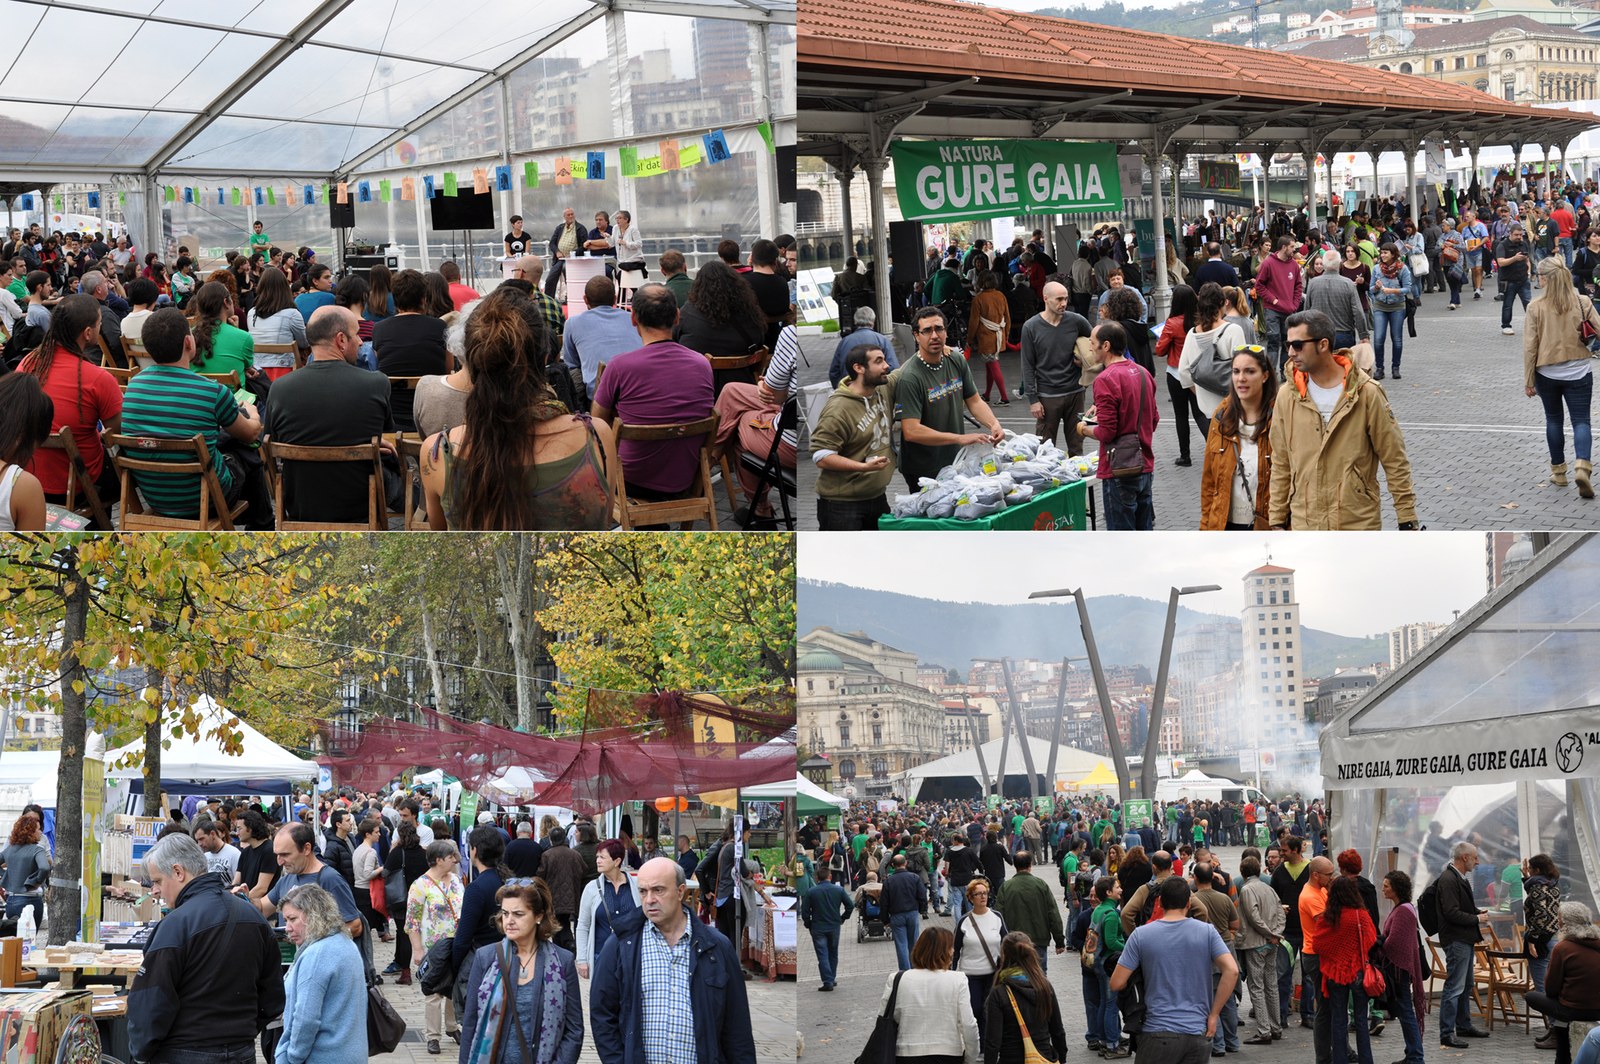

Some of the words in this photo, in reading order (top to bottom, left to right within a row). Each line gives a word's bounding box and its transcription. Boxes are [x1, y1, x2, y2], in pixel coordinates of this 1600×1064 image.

[939, 145, 1003, 163] NATURA
[915, 163, 1019, 210] GURE
[1027, 162, 1106, 203] GAIA
[1337, 762, 1363, 780] NIRE
[1365, 760, 1393, 778] GAIA,
[1395, 757, 1428, 776] ZURE
[1429, 754, 1465, 776] GAIA,
[1467, 750, 1507, 771] GURE
[1509, 747, 1548, 769] GAIA
[1127, 802, 1144, 813] 24
